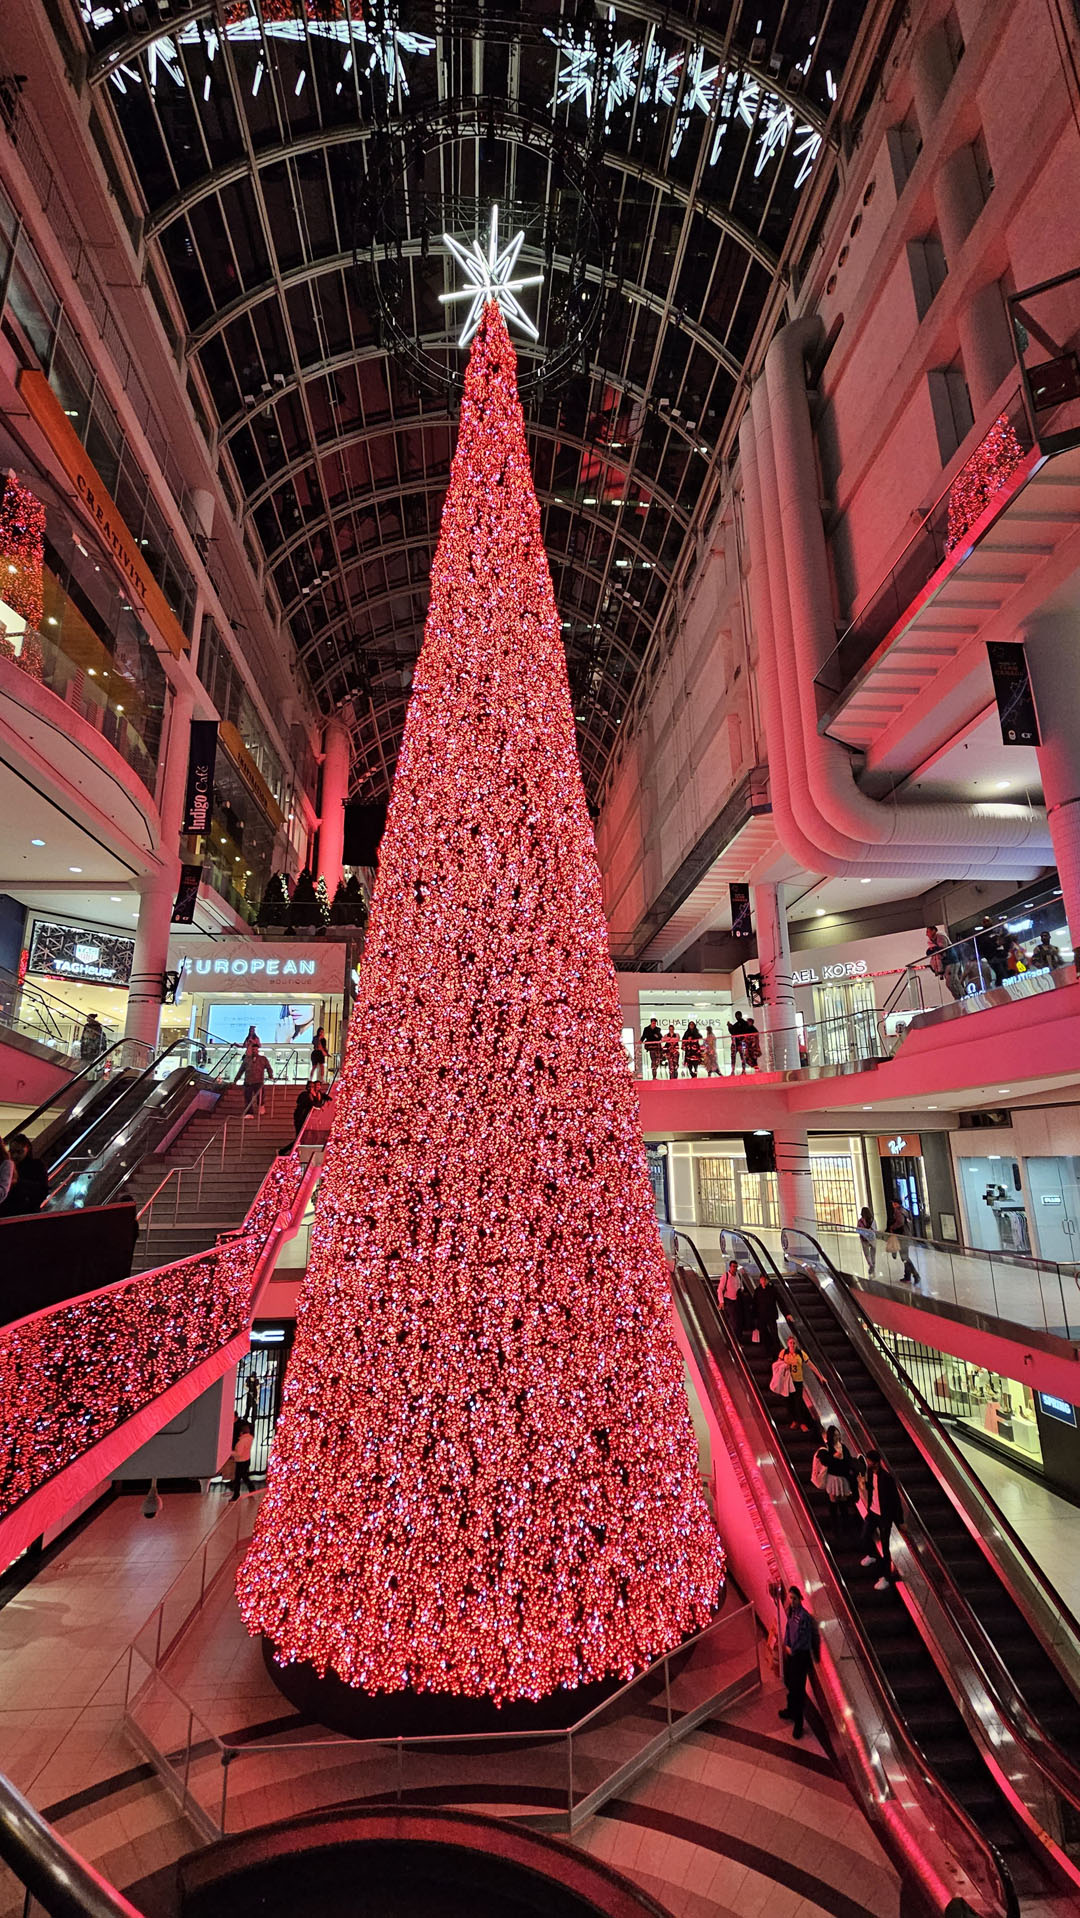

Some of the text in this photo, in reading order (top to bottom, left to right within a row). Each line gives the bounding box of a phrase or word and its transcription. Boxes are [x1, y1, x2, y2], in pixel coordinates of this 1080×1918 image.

[77, 474, 147, 598] CREATIVITY
[188, 765, 209, 830] Indigo Café
[178, 958, 316, 975] EUROPEAN
[823, 960, 868, 979] KORS
[695, 1018, 721, 1026] KORS
